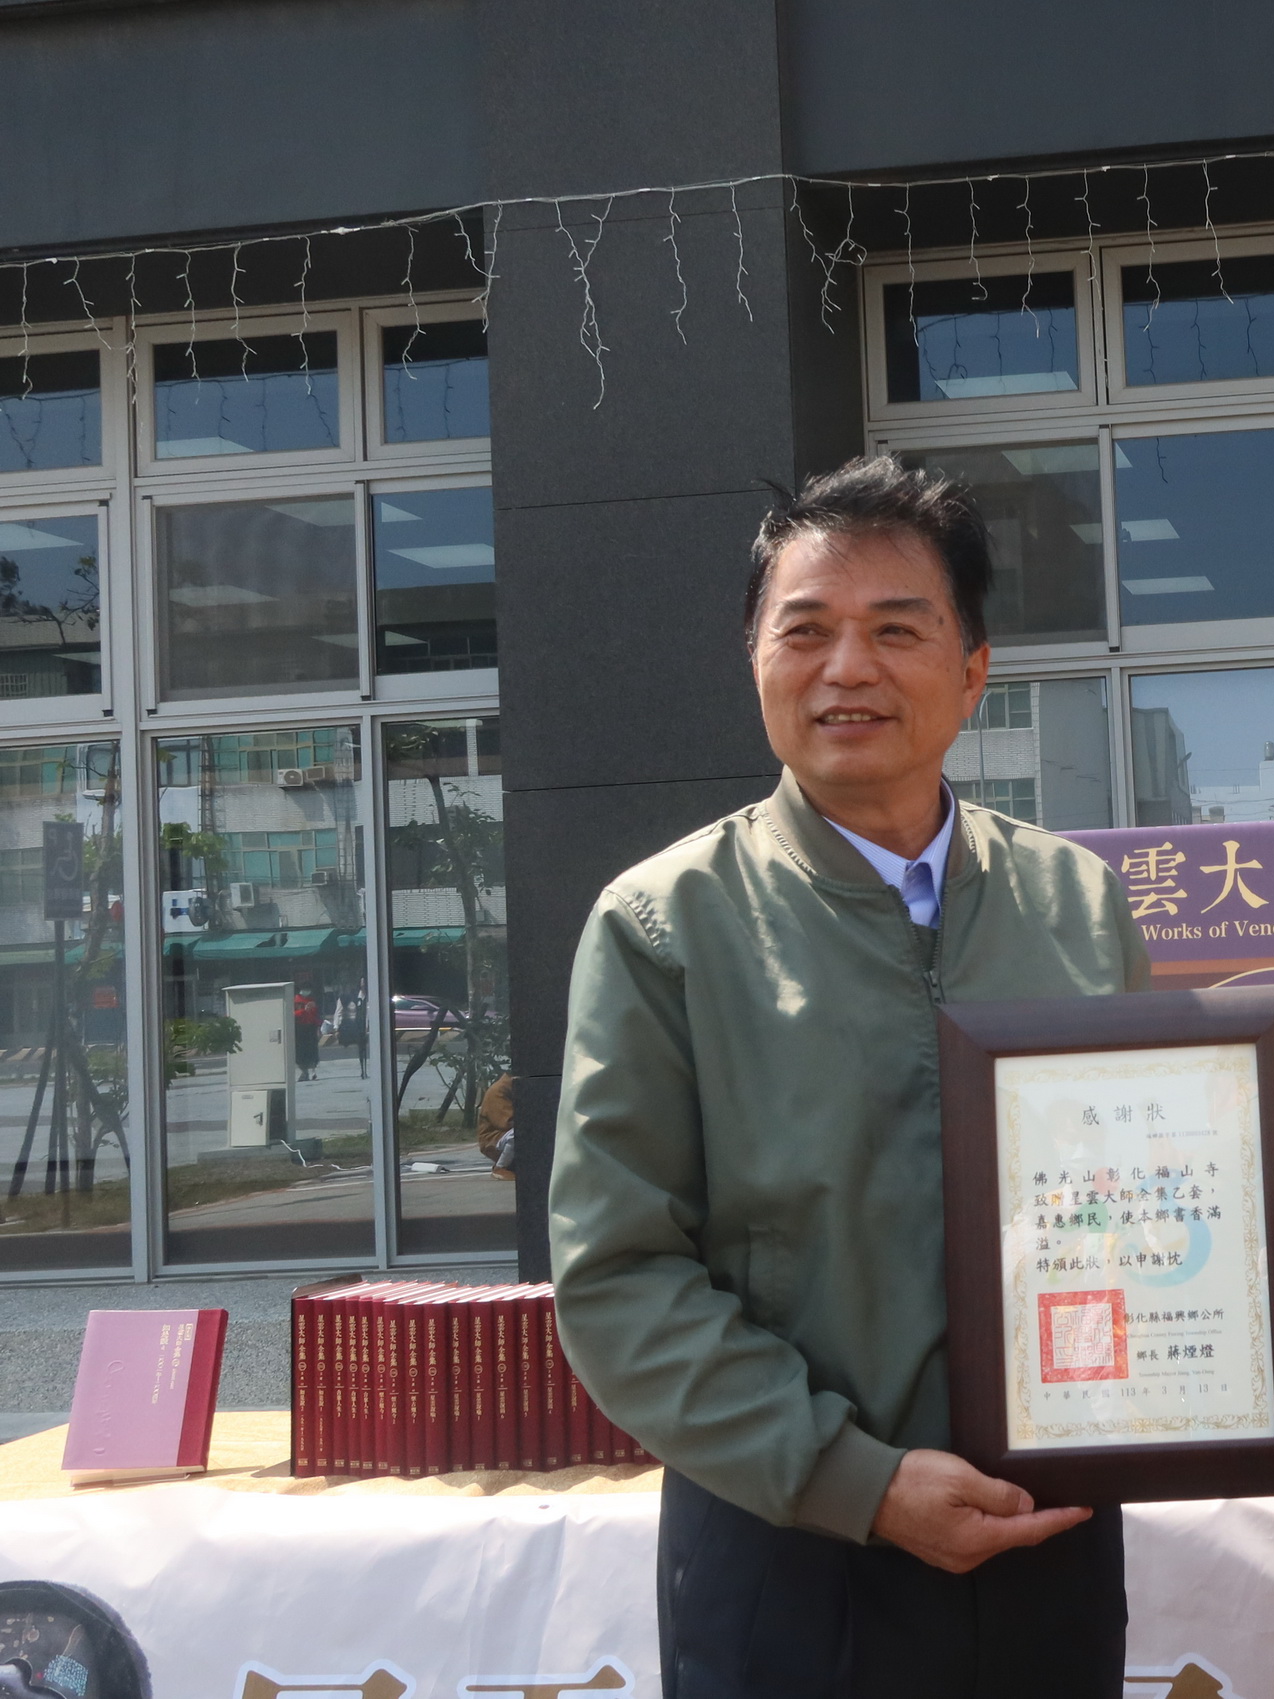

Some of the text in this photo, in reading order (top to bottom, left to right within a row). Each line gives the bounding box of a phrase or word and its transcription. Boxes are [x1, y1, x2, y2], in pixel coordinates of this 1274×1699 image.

[1141, 924, 1201, 941] Works
[1209, 921, 1227, 937] of
[1081, 1103, 1165, 1126] 感謝狀
[1033, 1162, 1219, 1186] 佛光山彰化福山寺
[1123, 1308, 1224, 1324] 彰化縣福興鄉公所
[1136, 1343, 1215, 1361] 鄉長 蔣煙燈
